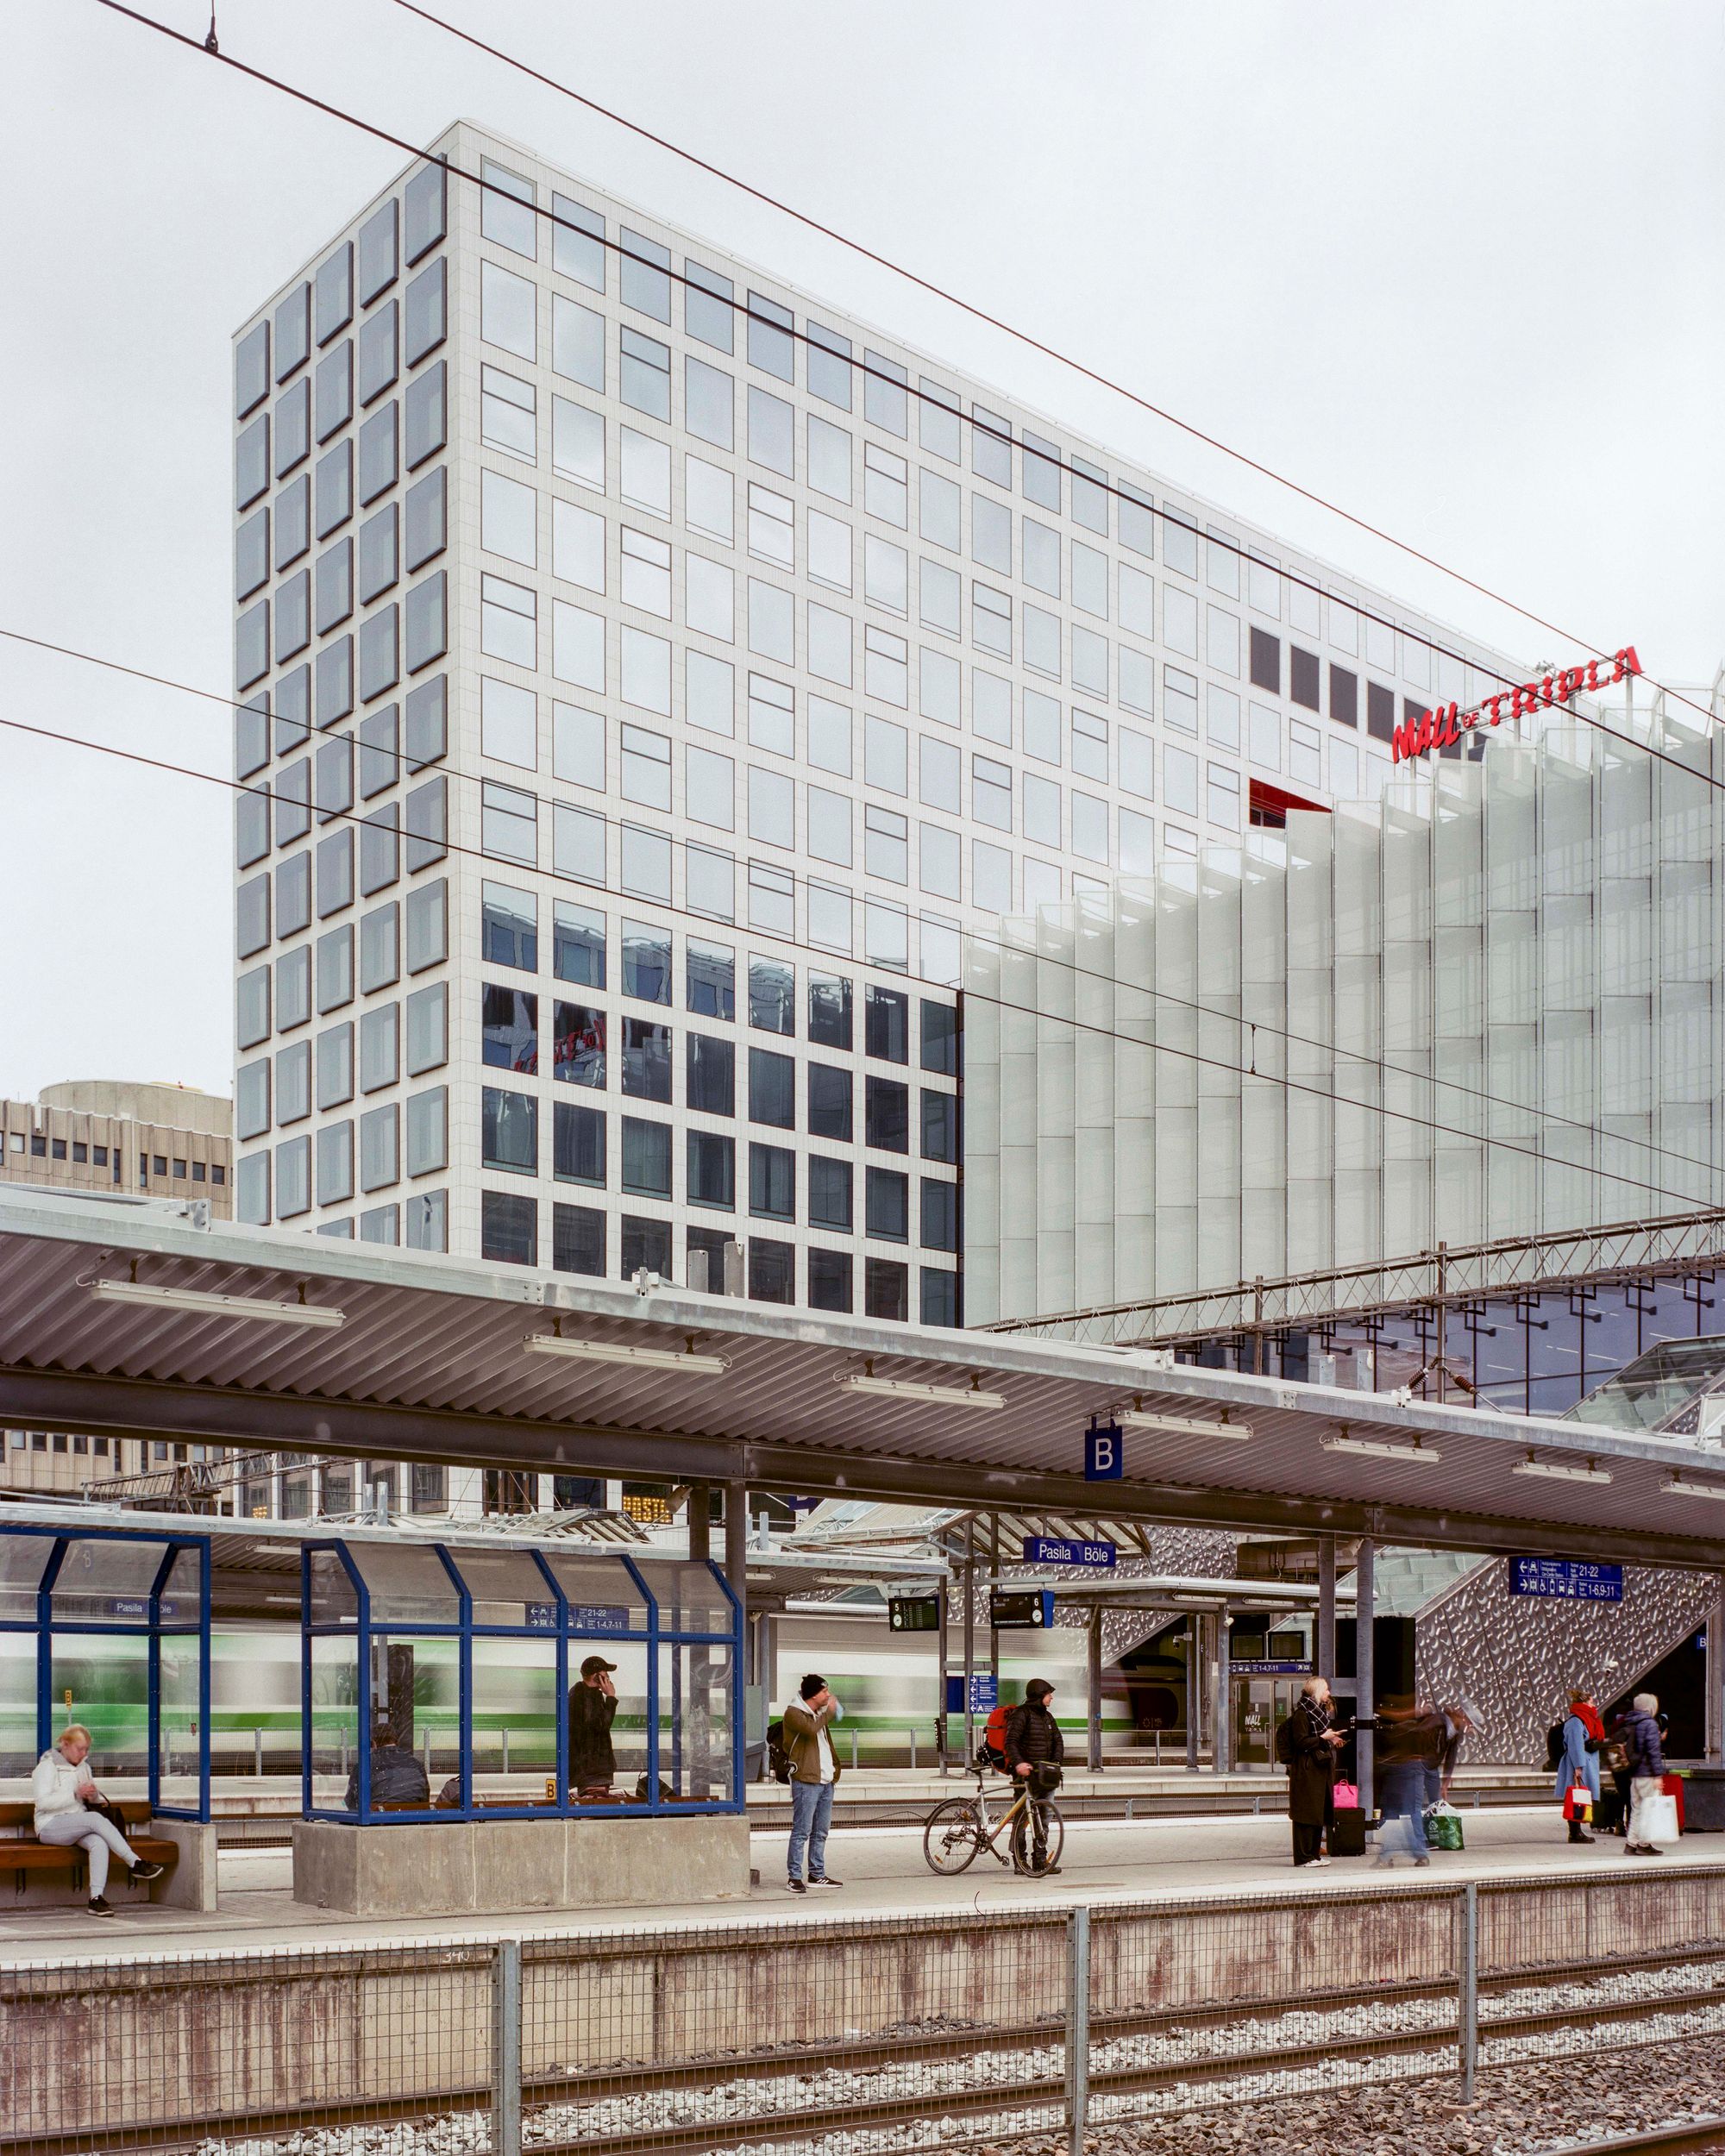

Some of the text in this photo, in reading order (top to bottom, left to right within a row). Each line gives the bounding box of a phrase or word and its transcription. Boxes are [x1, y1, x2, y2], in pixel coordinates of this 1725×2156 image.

[1392, 646, 1644, 764] MALL OF TRIPLA
[1095, 1438, 1113, 1470] B
[1039, 1545, 1108, 1562] Pasila Böle
[1578, 1565, 1599, 1577] 21-22
[894, 1603, 900, 1612] 5
[1034, 1597, 1039, 1607] 6
[116, 1603, 172, 1614] Pasila öle
[1700, 1637, 1707, 1647] B
[548, 1783, 555, 1798] B
[442, 1951, 470, 1963] 340
